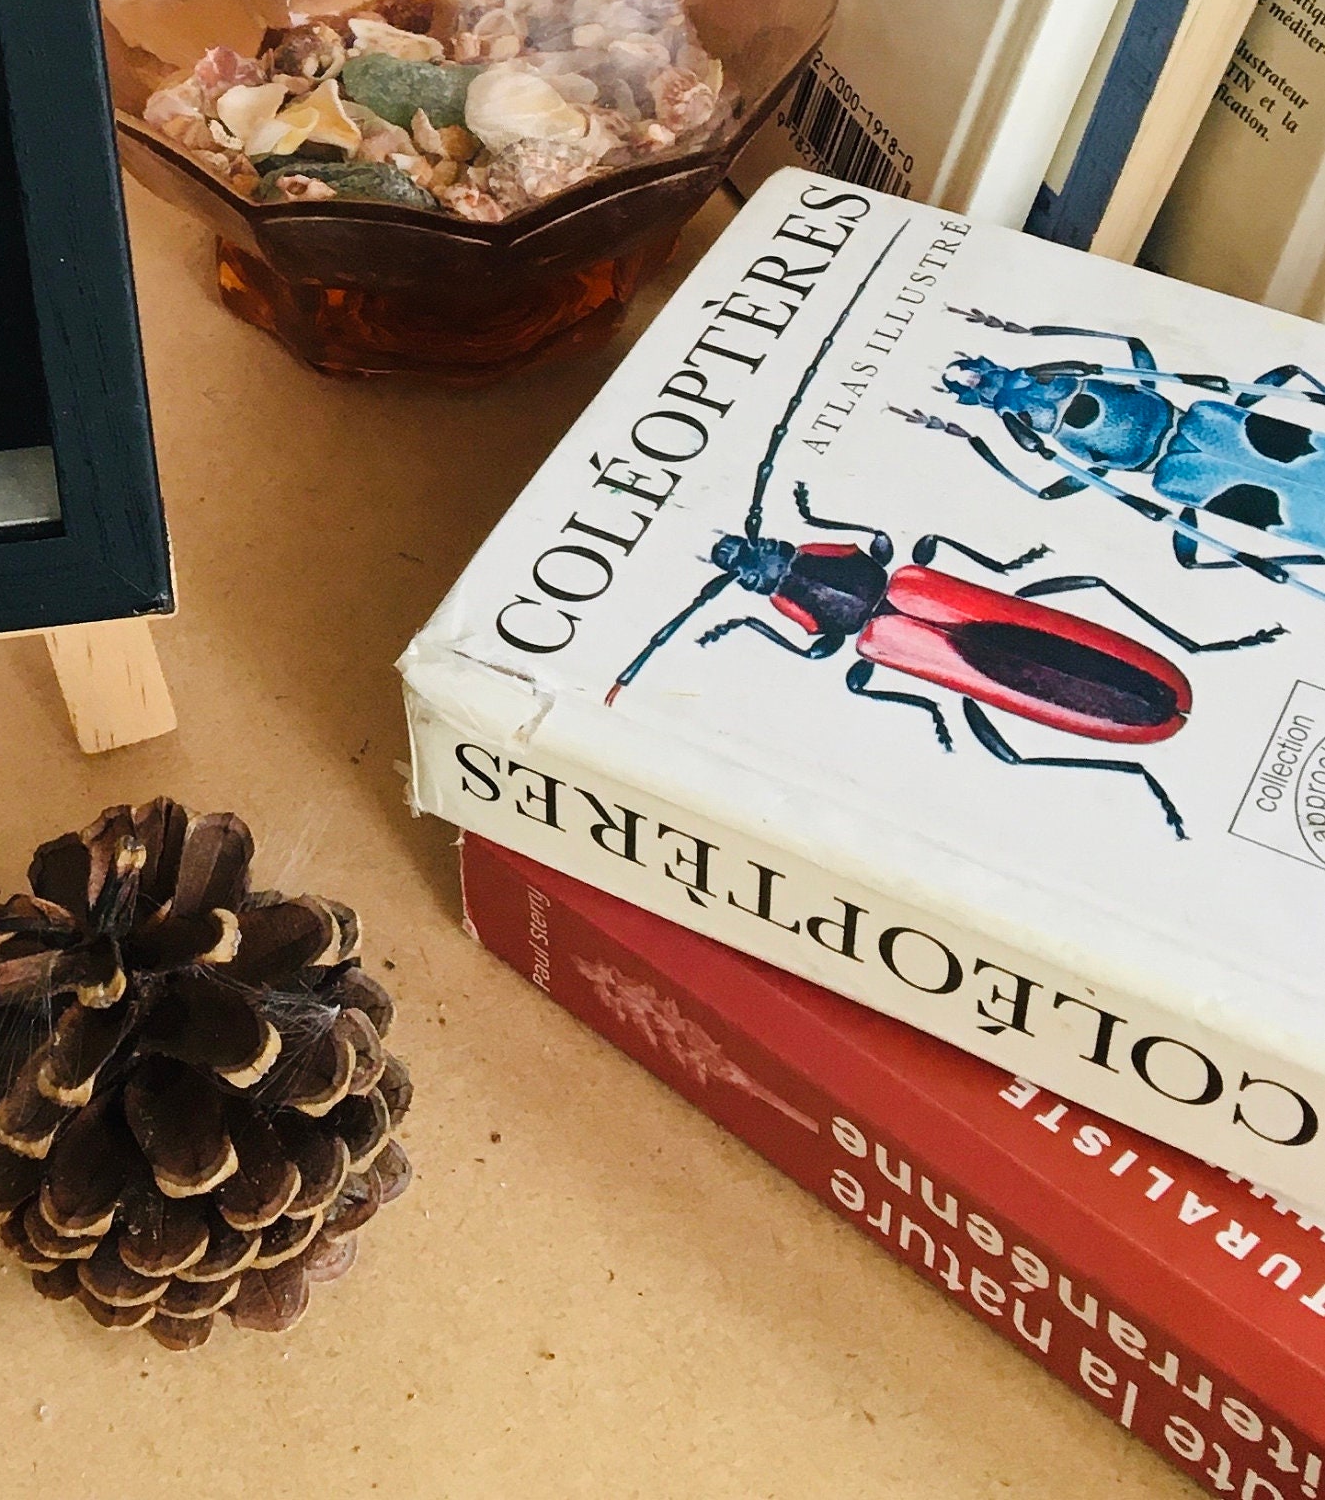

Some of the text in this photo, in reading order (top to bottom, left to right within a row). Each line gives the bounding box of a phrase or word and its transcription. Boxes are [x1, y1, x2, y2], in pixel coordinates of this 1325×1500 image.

[813, 50, 914, 174] 2-7000-1918-0
[1259, 96, 1276, 114] et
[1281, 111, 1299, 134] la
[801, 220, 973, 456] ATLAS ILLUSTRÉ
[494, 183, 872, 656] COLÉOPTÈRES
[1256, 713, 1316, 813] collection
[454, 742, 1319, 1149] COLÉOPTÈRES
[526, 884, 551, 993] Paul Sterry
[830, 1167, 1053, 1355] nature
[1078, 1346, 1139, 1430] la
